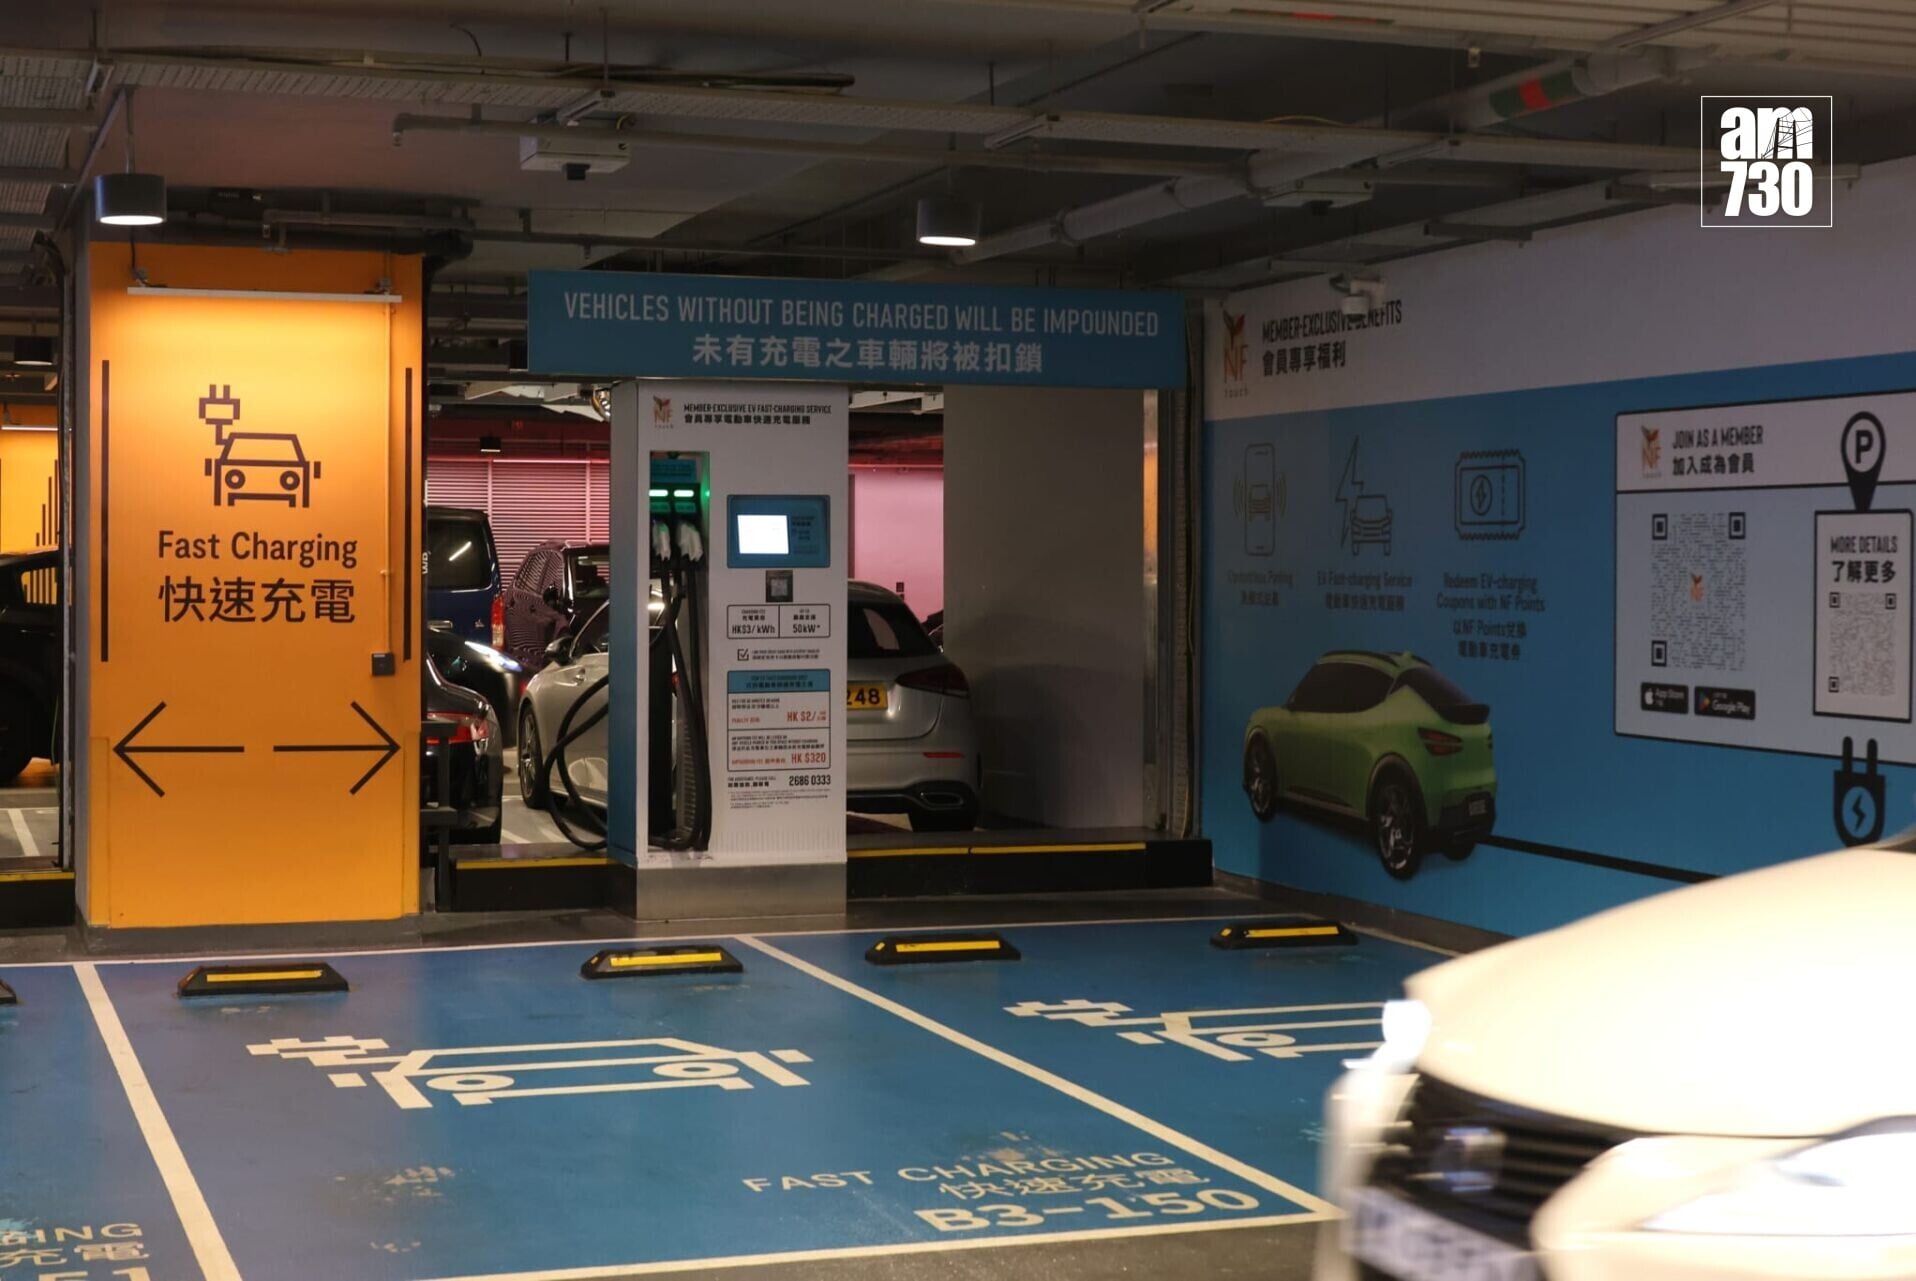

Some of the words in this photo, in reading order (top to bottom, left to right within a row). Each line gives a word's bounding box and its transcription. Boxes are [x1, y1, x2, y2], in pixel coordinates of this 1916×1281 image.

[564, 292, 669, 321] VEHICLES
[677, 296, 773, 325] WITHOUT
[781, 299, 844, 327] BEING
[852, 302, 948, 331] CHARGED
[955, 305, 1003, 332] WILL
[1011, 307, 1036, 333] BE
[1043, 309, 1159, 337] IMPOUNDED
[1356, 299, 1403, 329] NEFITS
[692, 333, 1043, 374] 未有充電之車輛將被扣鎖
[1262, 340, 1346, 377] 會員專享福利
[684, 403, 746, 413] MEMBER-EXCLUSIVE
[757, 404, 805, 414] FAST-CHARGING
[807, 404, 831, 414] SERVICE
[1672, 430, 1694, 449] JOIN
[1697, 428, 1709, 448] AS
[1711, 428, 1718, 448] A
[1721, 425, 1763, 446] MEMBER
[1856, 430, 1874, 464] P
[1672, 452, 1755, 476] 加入成為會員
[158, 530, 220, 559] Fast
[230, 531, 358, 569] Charging
[1830, 536, 1857, 553] MORE
[1859, 536, 1898, 553] DETAILS
[1832, 560, 1896, 583] 了解更多
[158, 575, 355, 623] 快速充電
[811, 774, 831, 785] 0333
[742, 1170, 874, 1193] FAST
[898, 1152, 1175, 1182] CHARGING
[939, 1168, 1210, 1200] 快速充電
[913, 1188, 1260, 1232] B3-150
